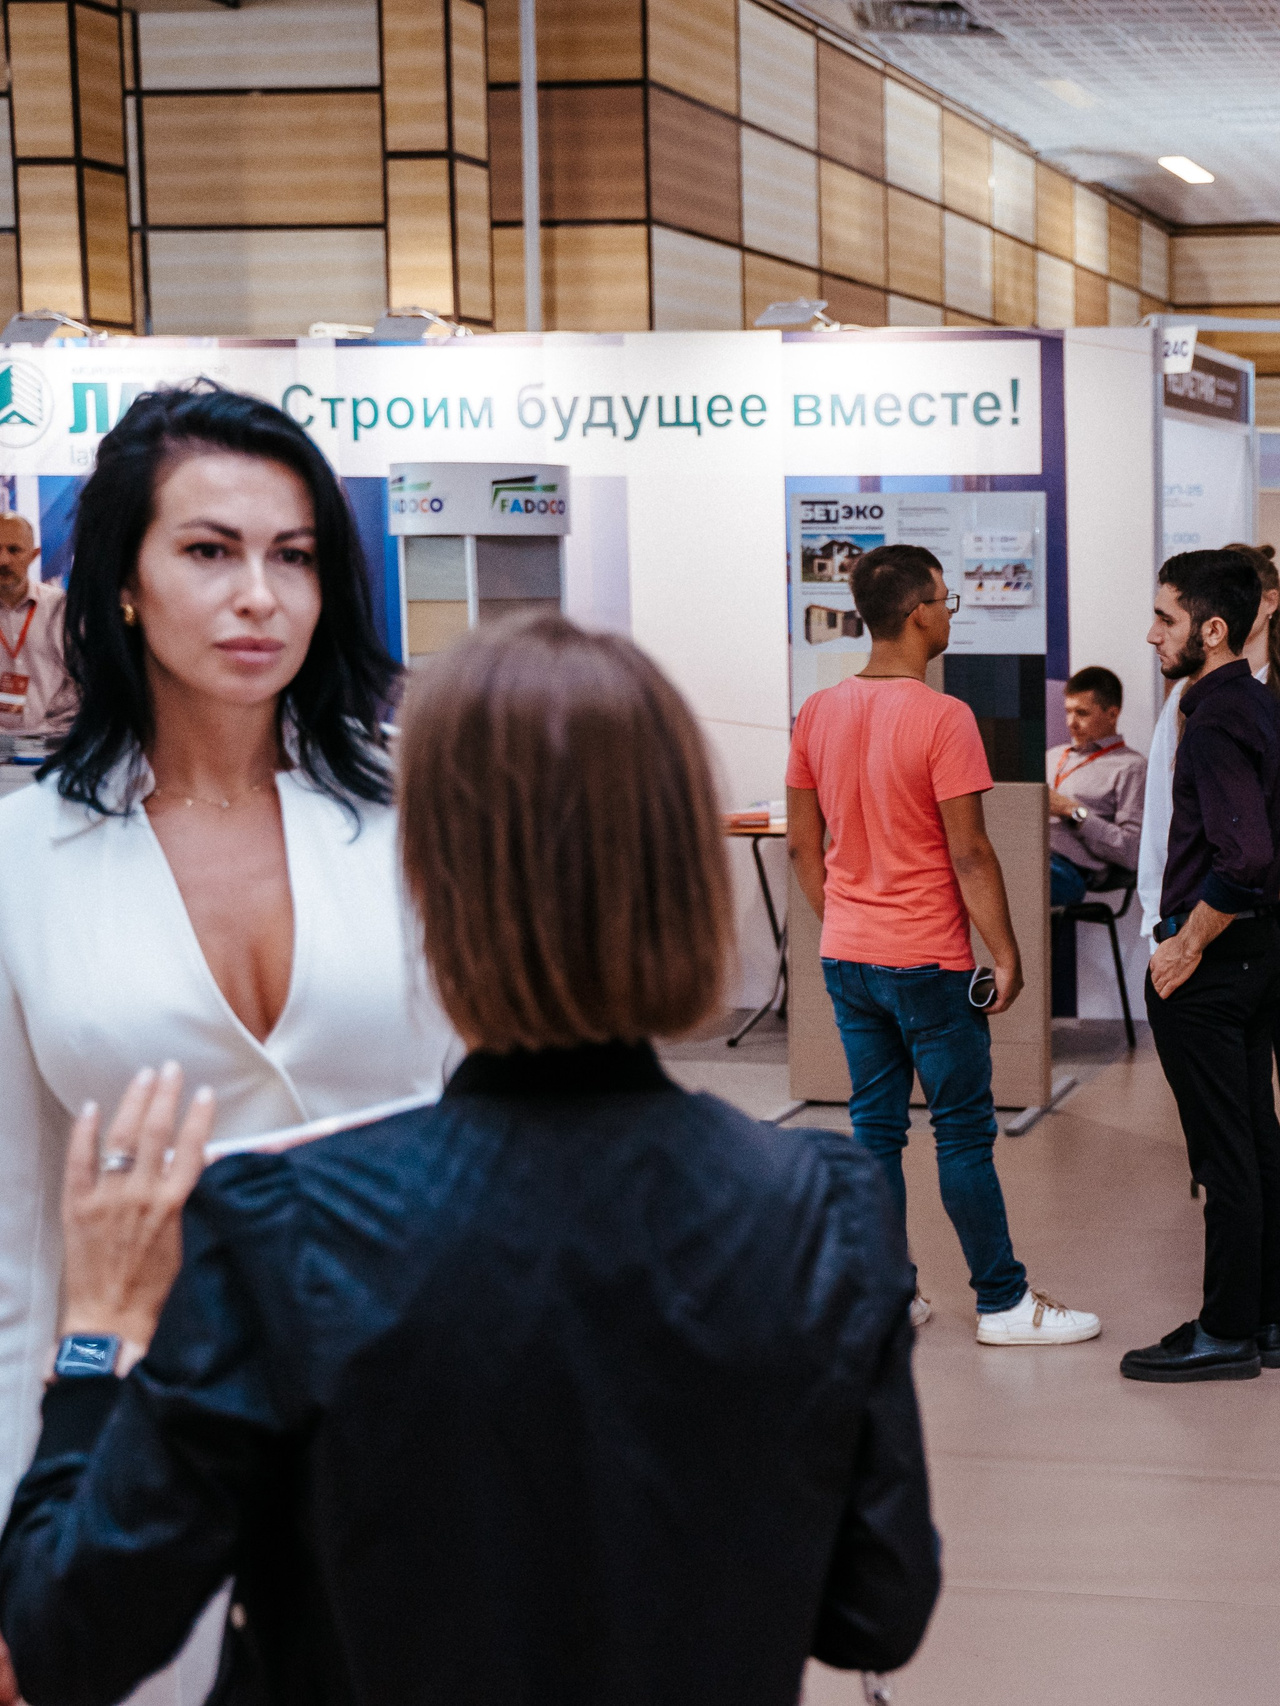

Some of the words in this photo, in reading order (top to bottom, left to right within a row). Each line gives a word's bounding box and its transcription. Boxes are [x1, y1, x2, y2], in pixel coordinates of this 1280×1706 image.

[281, 383, 494, 441] Строим
[516, 381, 767, 441] будущее
[792, 378, 1020, 427] вместе!
[500, 497, 566, 515] FADOCO
